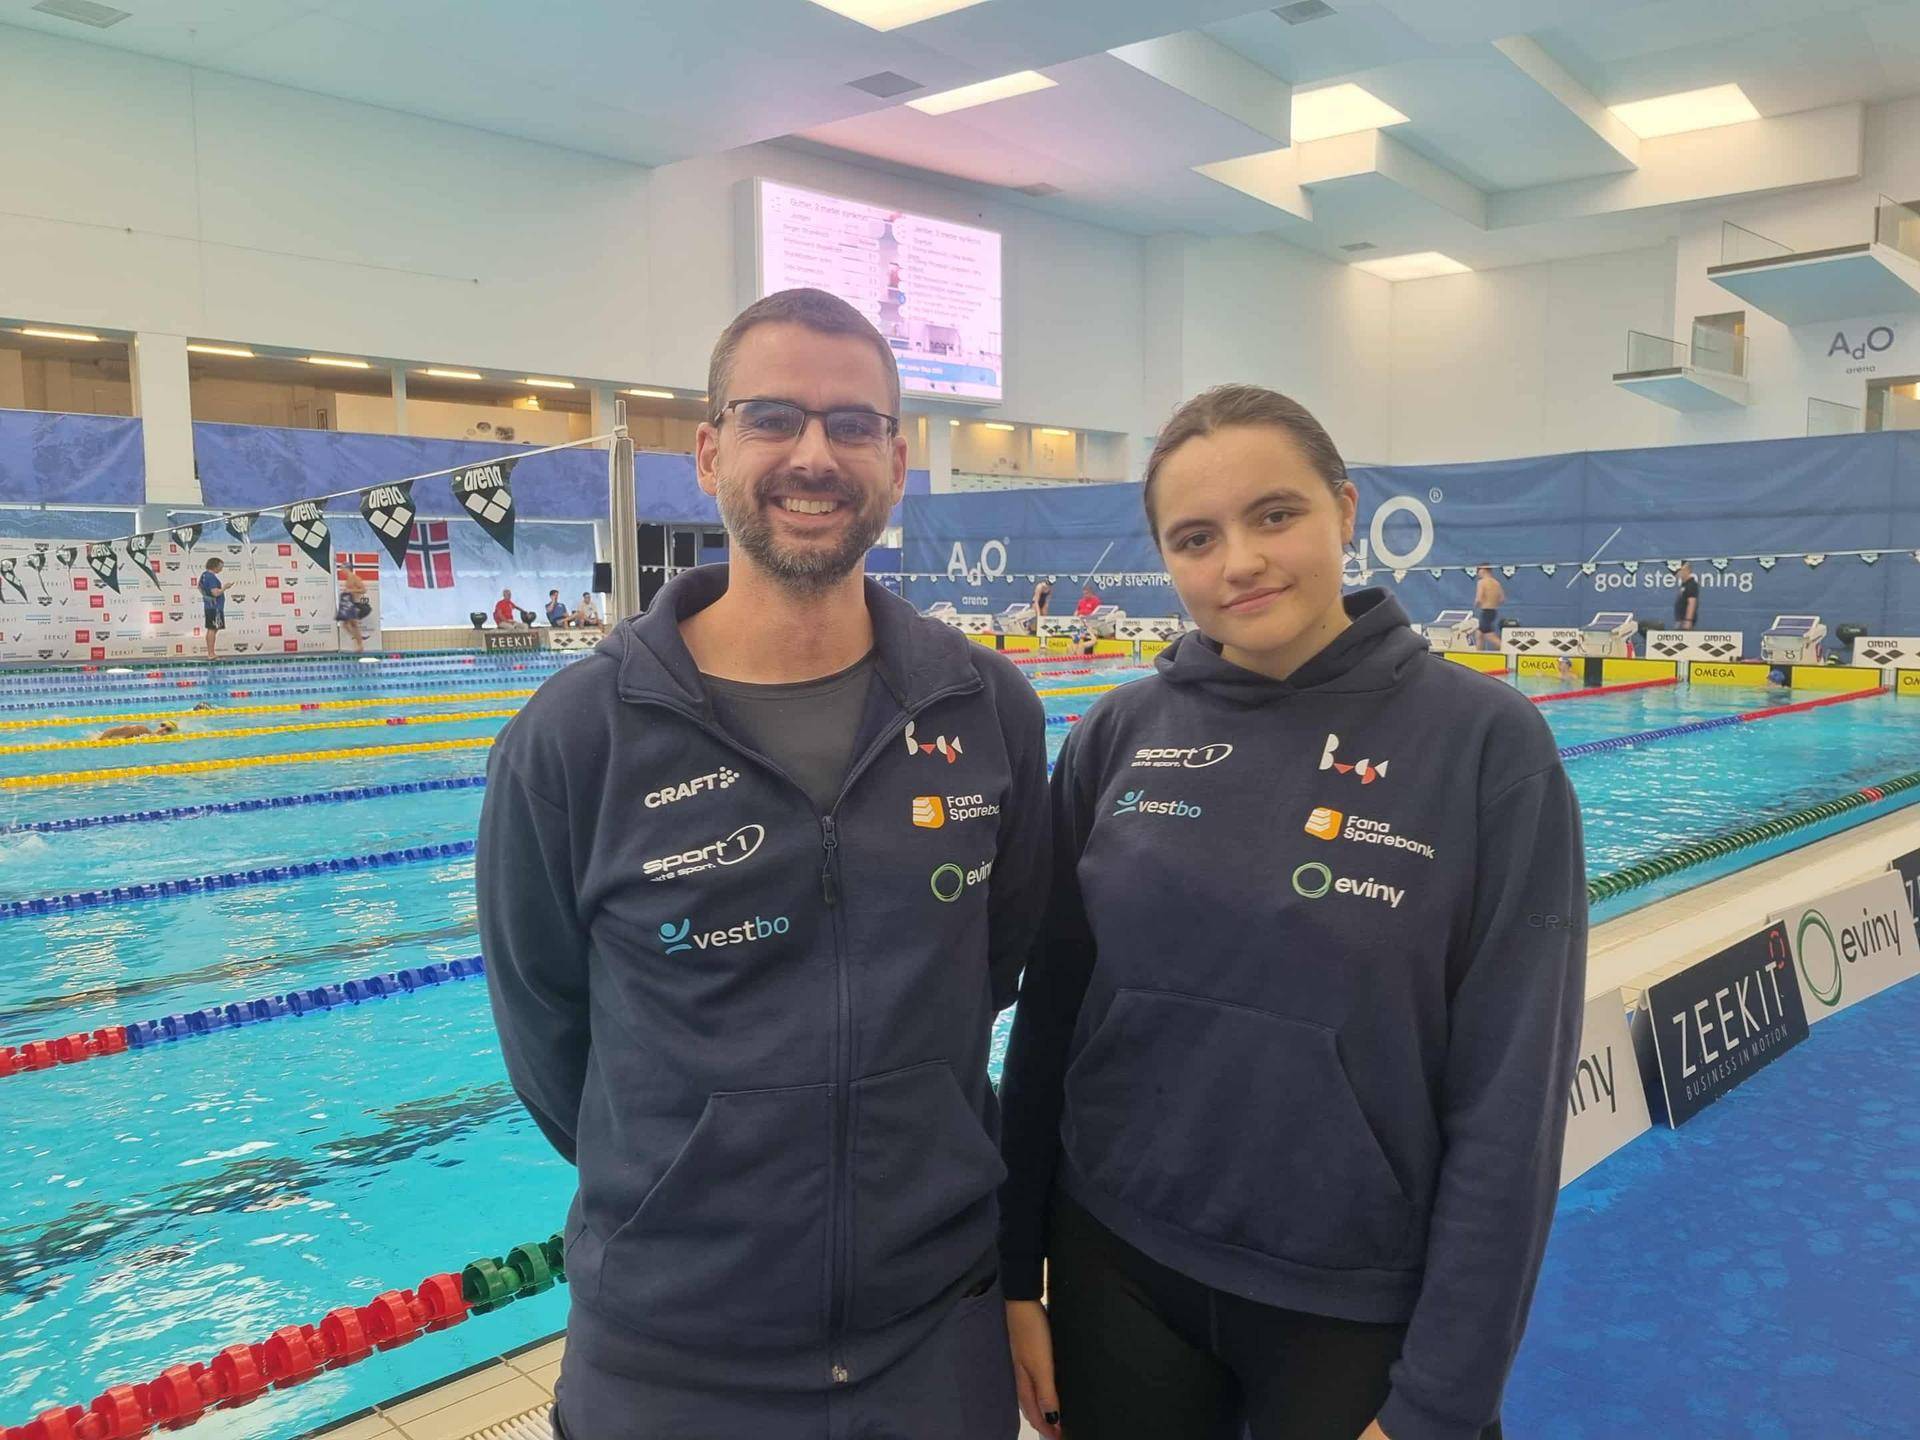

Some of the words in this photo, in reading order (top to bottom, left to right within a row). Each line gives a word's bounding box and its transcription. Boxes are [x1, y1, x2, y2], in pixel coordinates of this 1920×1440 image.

[1827, 327, 1895, 360] AdO
[464, 465, 504, 491] arena
[369, 486, 406, 509] arena
[948, 540, 1007, 586] AdO
[962, 595, 988, 606] arena
[491, 636, 533, 648] ZEEKIT
[1657, 634, 1684, 642] arena
[1521, 661, 1555, 670] OMEGA
[1694, 668, 1736, 678] OMEGA
[644, 773, 719, 808] CRAFT
[946, 794, 983, 808] Fana
[1139, 801, 1202, 818] vestbo
[1346, 815, 1391, 833] Fana
[1343, 827, 1436, 859] Sparebank
[1335, 877, 1405, 908] eviny
[693, 916, 789, 949] vestbo
[1841, 908, 1901, 963] eviny
[1672, 961, 1784, 1079] ZEEKIT
[1686, 1058, 1737, 1101] BUSINESS
[1740, 1049, 1750, 1066] IN
[1752, 1024, 1788, 1055] MOTION
